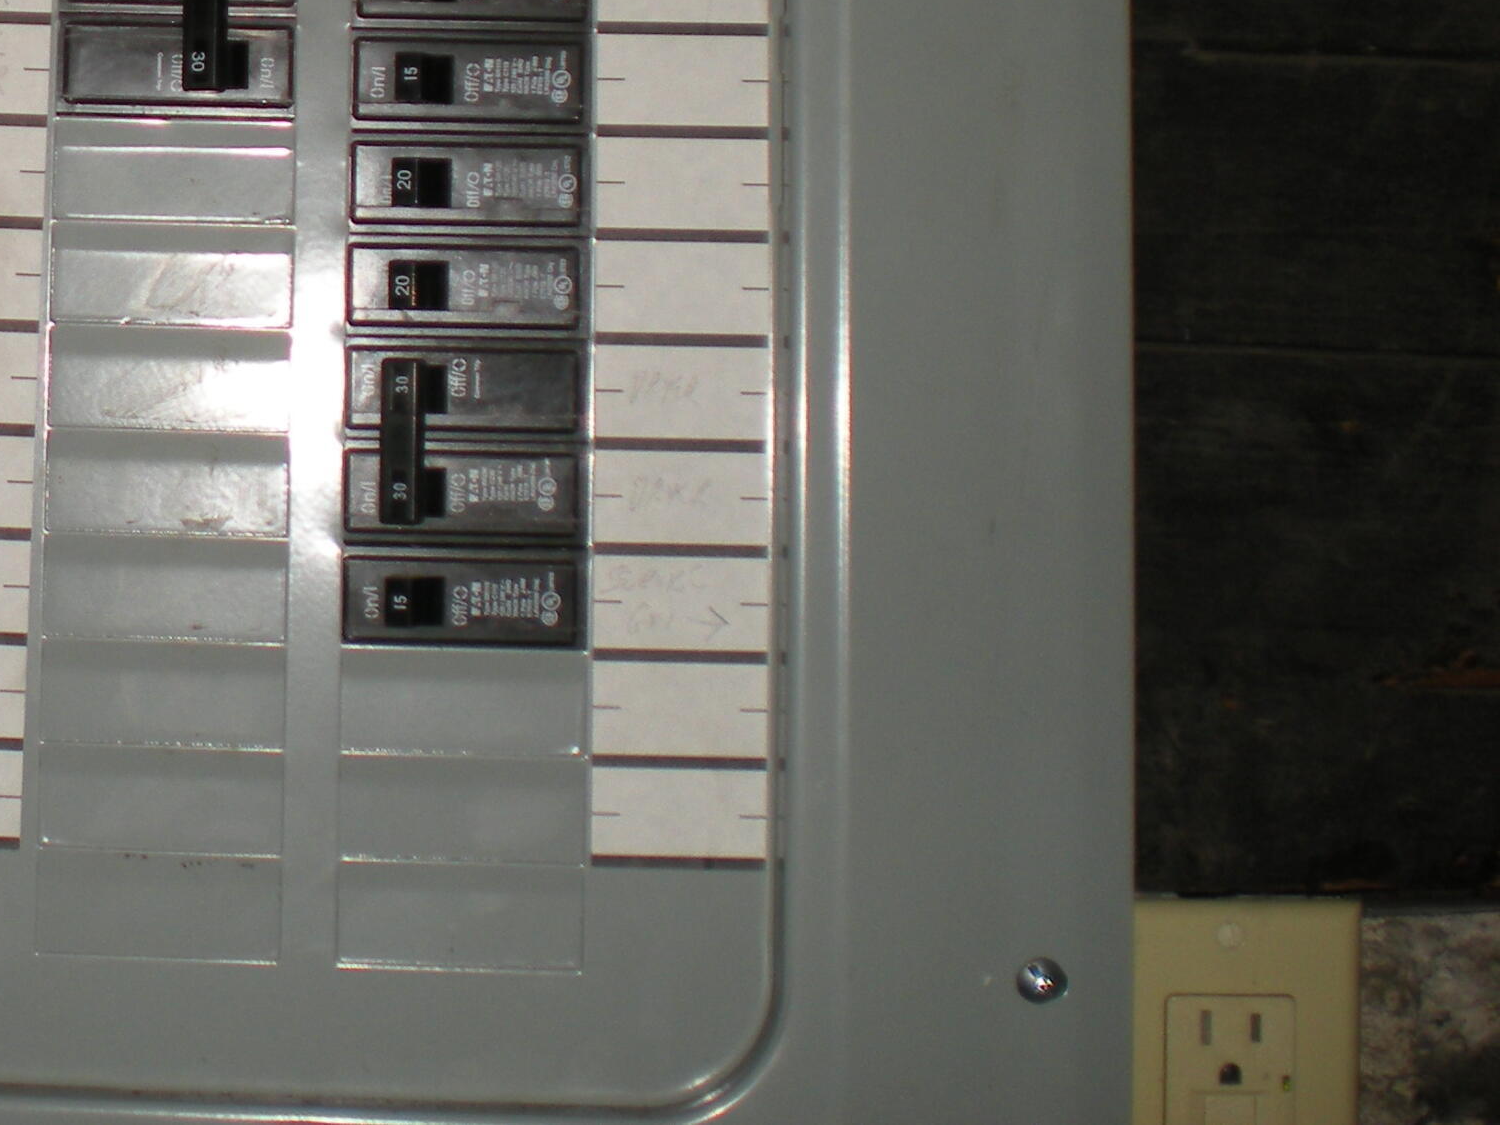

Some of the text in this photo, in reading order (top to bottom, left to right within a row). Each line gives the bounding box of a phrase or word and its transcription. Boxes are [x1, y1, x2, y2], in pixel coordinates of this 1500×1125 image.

[190, 50, 206, 73] 30
[403, 66, 419, 82] 15
[396, 169, 412, 191] 20
[394, 275, 411, 297] 20
[395, 375, 410, 395] 30
[392, 481, 408, 501] 30
[393, 593, 408, 610] 15
